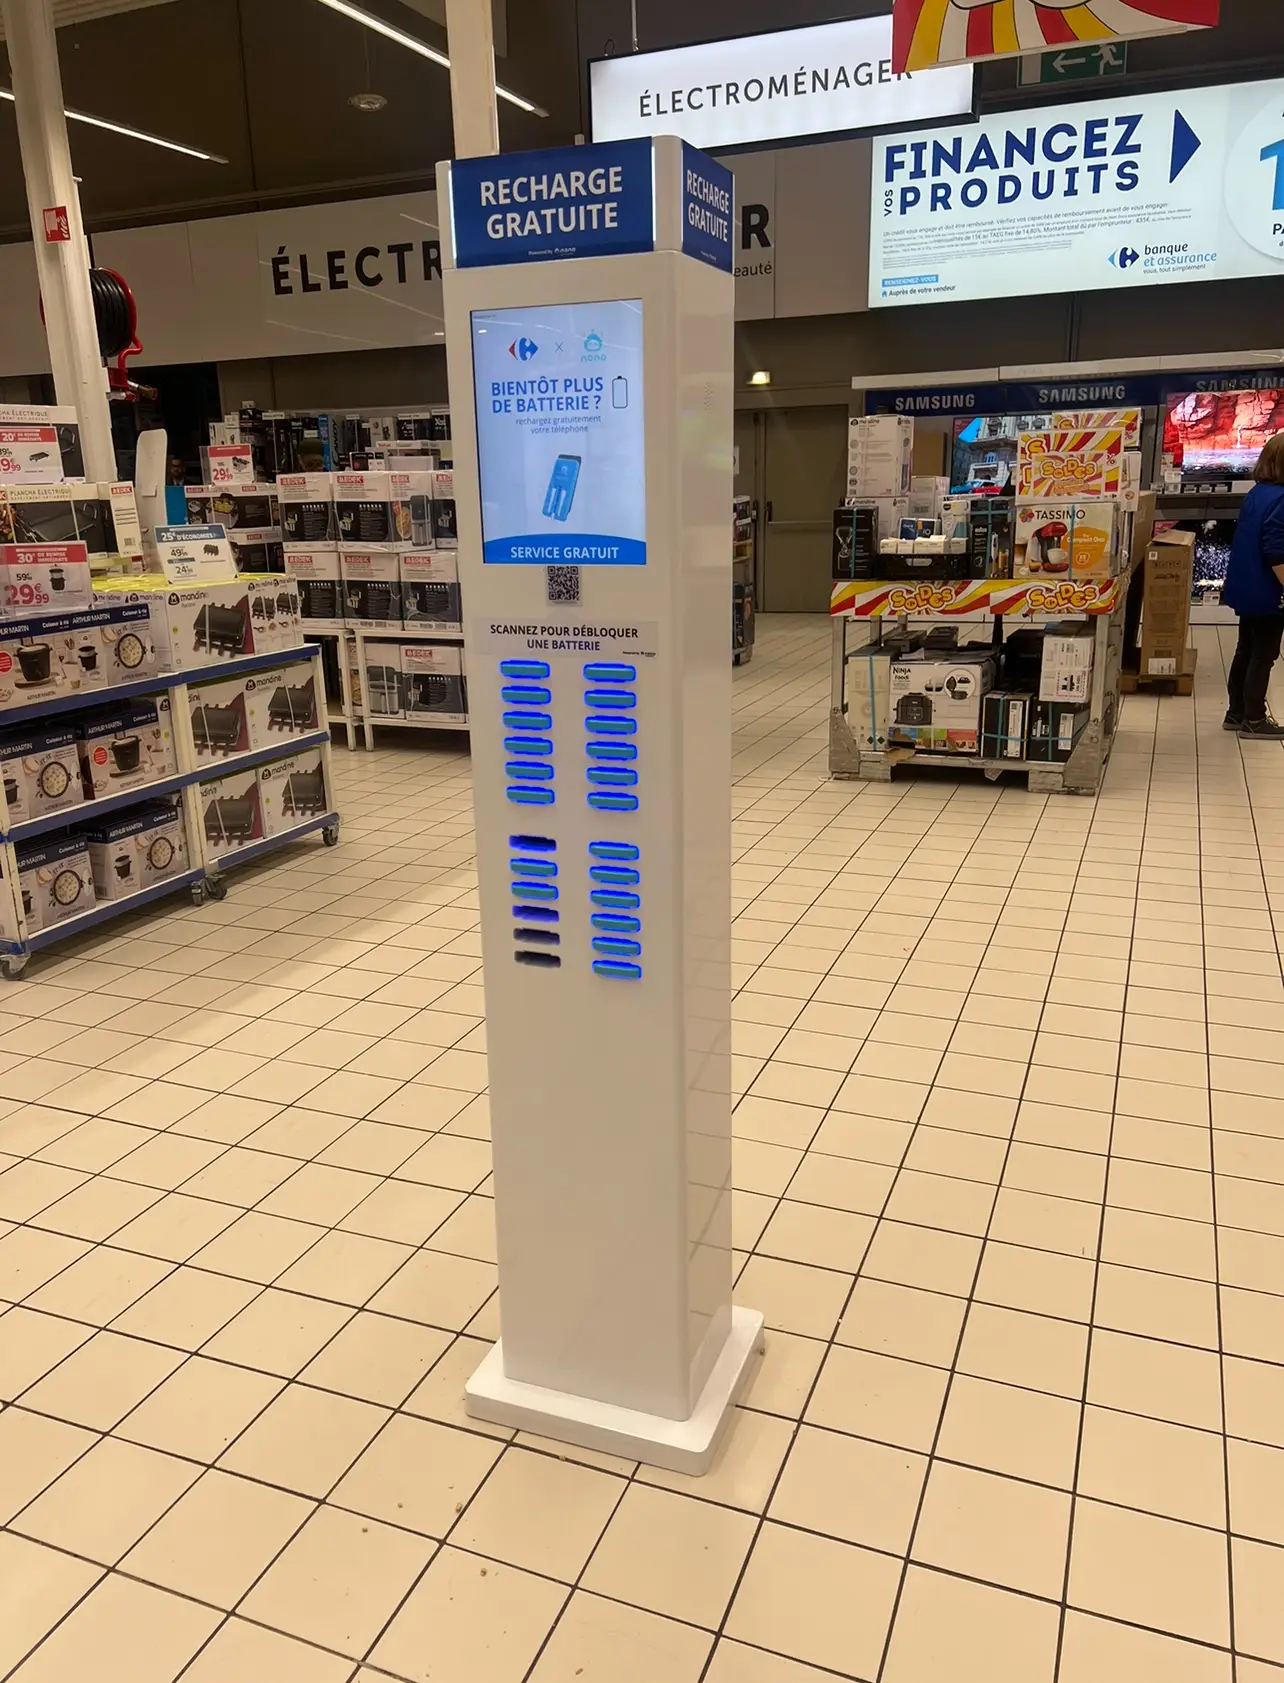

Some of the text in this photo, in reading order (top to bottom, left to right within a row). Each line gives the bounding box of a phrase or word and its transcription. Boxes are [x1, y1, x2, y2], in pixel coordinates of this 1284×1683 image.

[885, 114, 1144, 183] FINANCEZ
[480, 166, 623, 207] RECHARGE
[686, 169, 730, 215] RECHARGE
[900, 160, 1140, 216] PRODUITS
[883, 189, 894, 217] VOS
[486, 202, 618, 239] GRATUITE
[687, 202, 728, 242] GRATUITE
[918, 226, 938, 234] engage
[997, 216, 1016, 224] Vérifiez
[1027, 212, 1054, 222] capacités
[1062, 208, 1105, 218] remboursement
[1043, 224, 1065, 232] Montant
[1144, 242, 1188, 257] banque
[1144, 252, 1217, 266] et assurance
[1172, 264, 1206, 272] simplement
[889, 288, 909, 297] Auprès
[580, 354, 607, 363] nono
[491, 376, 604, 396] BIENTÔT PLUS
[1195, 376, 1284, 391] SAMSUN
[1038, 384, 1126, 404] SAMSUNG
[492, 395, 602, 414] DE BATTERIE ?
[895, 393, 976, 411] SAMSUNG
[12, 409, 48, 417] ÉLECTRIQUE
[516, 415, 602, 426] rechargez gratuitement
[530, 424, 589, 434] votre téléphone
[1035, 509, 1086, 520] TASSIMO
[510, 546, 620, 559] SERVICE GRATUIT
[72, 612, 110, 624] ARTHUR MARTIN
[490, 624, 638, 640] SCANNEZ POUR DÉBLOQUER
[527, 640, 600, 650] UNE BATTERIE
[88, 720, 122, 734] ARTHUR MARTIN
[14, 742, 32, 753] MARTIN
[109, 828, 125, 838] ARTHUR
[126, 822, 144, 832] MARTIN
[27, 854, 46, 865] MARTIN
